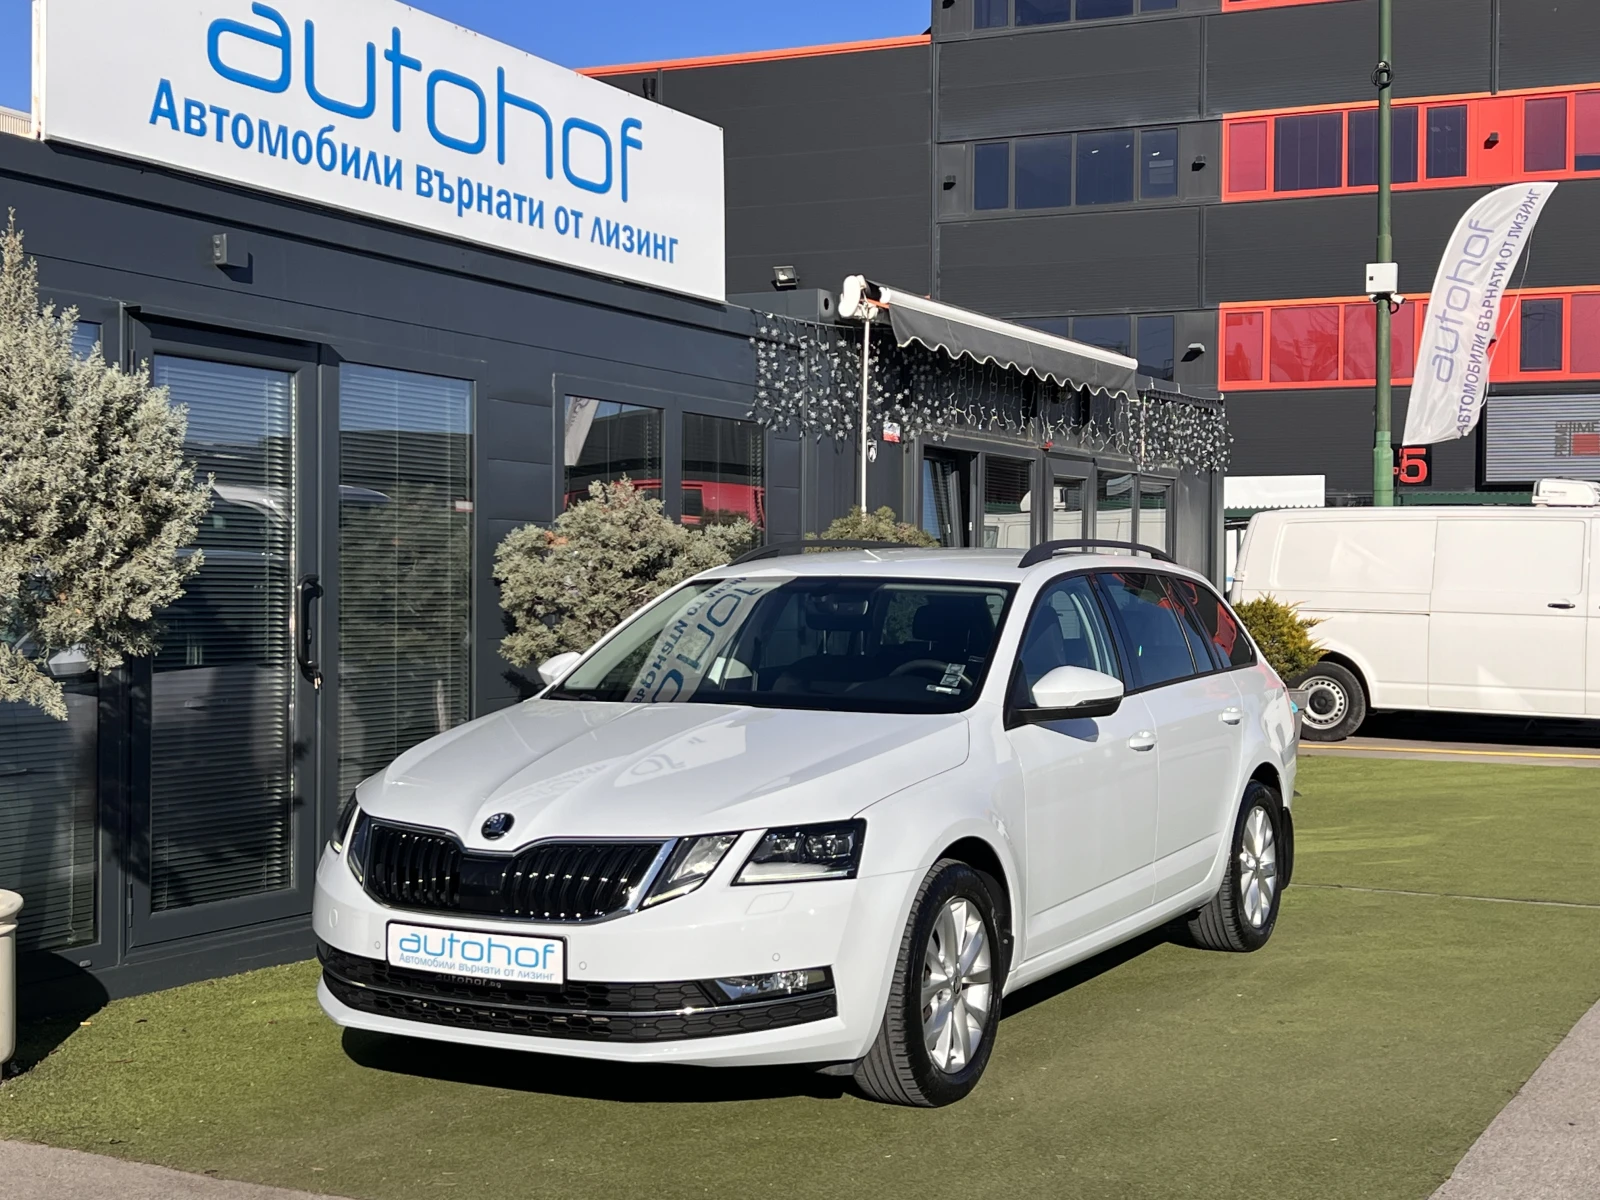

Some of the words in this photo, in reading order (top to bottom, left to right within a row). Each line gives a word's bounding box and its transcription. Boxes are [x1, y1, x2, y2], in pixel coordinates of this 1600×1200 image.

[149, 78, 403, 190] Автомобили
[416, 164, 545, 229] върнати
[553, 205, 583, 238] от
[590, 216, 679, 264] лизинг
[207, 1, 643, 203] autohof
[1431, 218, 1495, 383] autohof
[1456, 333, 1487, 434] АВТОМОБИЛИ
[1476, 261, 1509, 332] ВЪРНАТИ
[1498, 241, 1516, 259] ОТ
[1507, 188, 1541, 239] ЛИЗИНГ
[399, 932, 555, 970] autohof
[399, 952, 456, 970] Автомобили
[458, 962, 502, 975] върнати
[503, 968, 516, 977] от
[517, 970, 555, 982] лизинг
